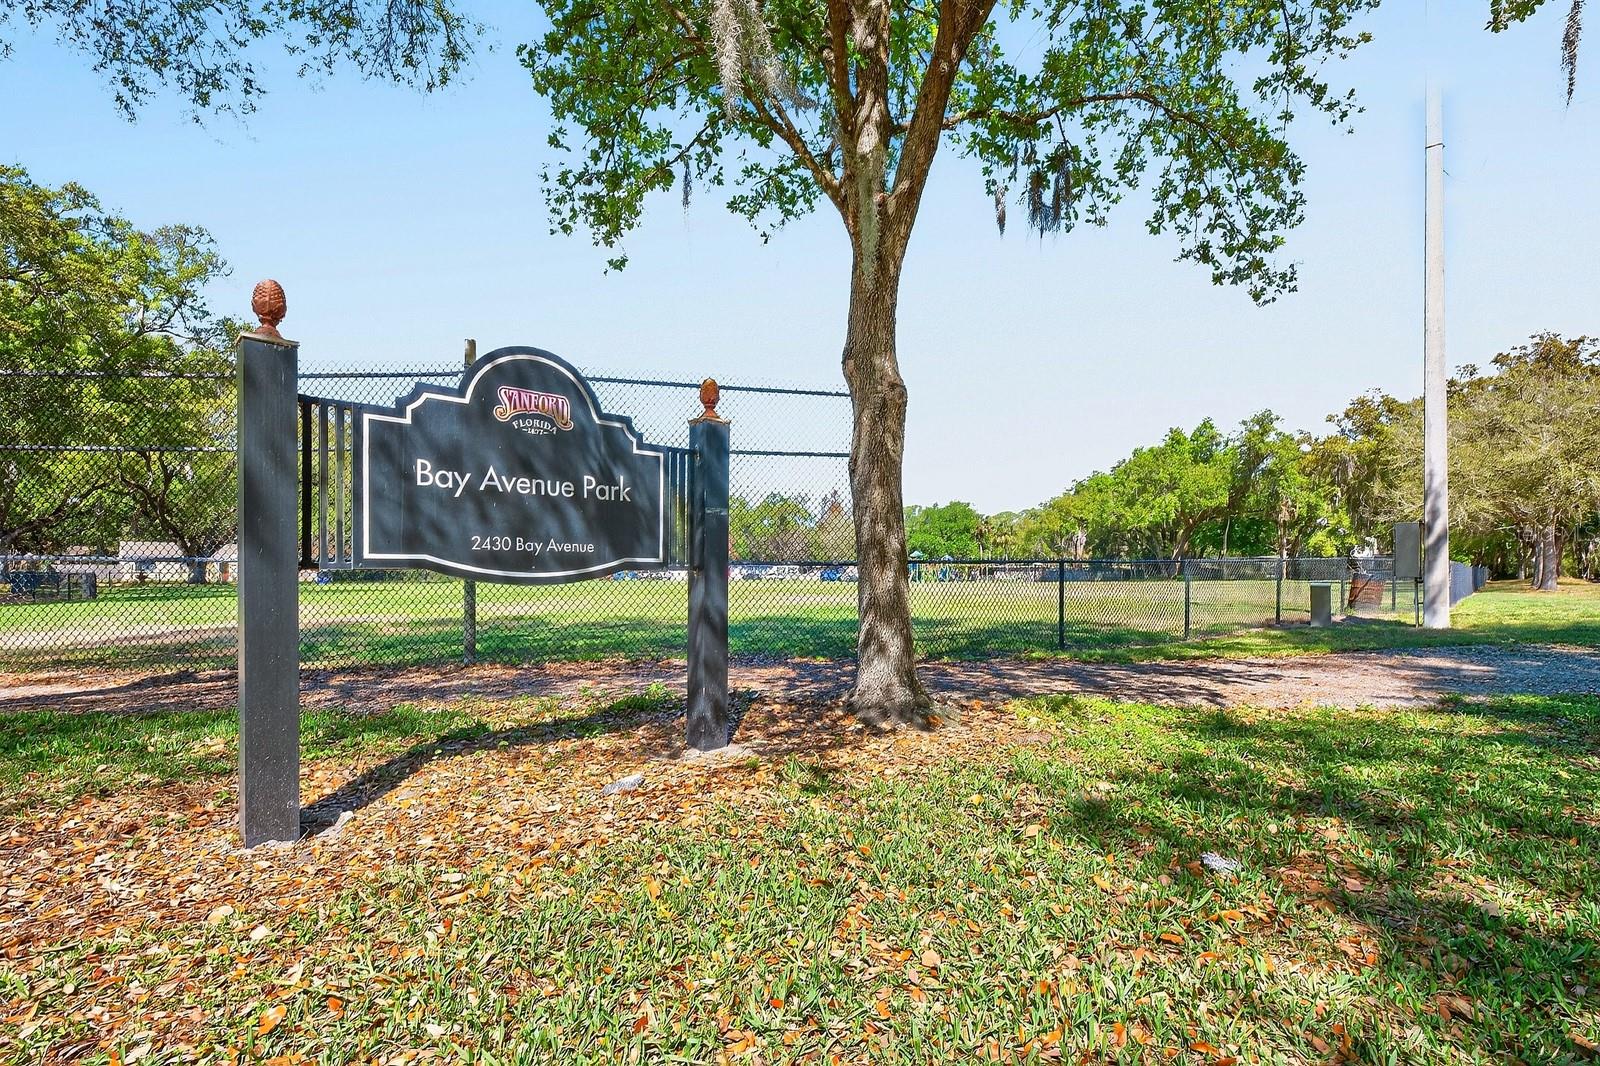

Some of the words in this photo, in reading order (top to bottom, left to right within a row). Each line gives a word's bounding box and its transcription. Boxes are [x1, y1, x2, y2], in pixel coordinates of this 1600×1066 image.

[494, 386, 574, 431] SANFORD
[512, 418, 557, 435] FLORIDA
[416, 458, 472, 498] Bay
[479, 465, 575, 498] Avenue
[583, 475, 632, 502] Park
[471, 535, 512, 551] 2430
[516, 537, 543, 556] Bay
[546, 538, 595, 553] Avenue
